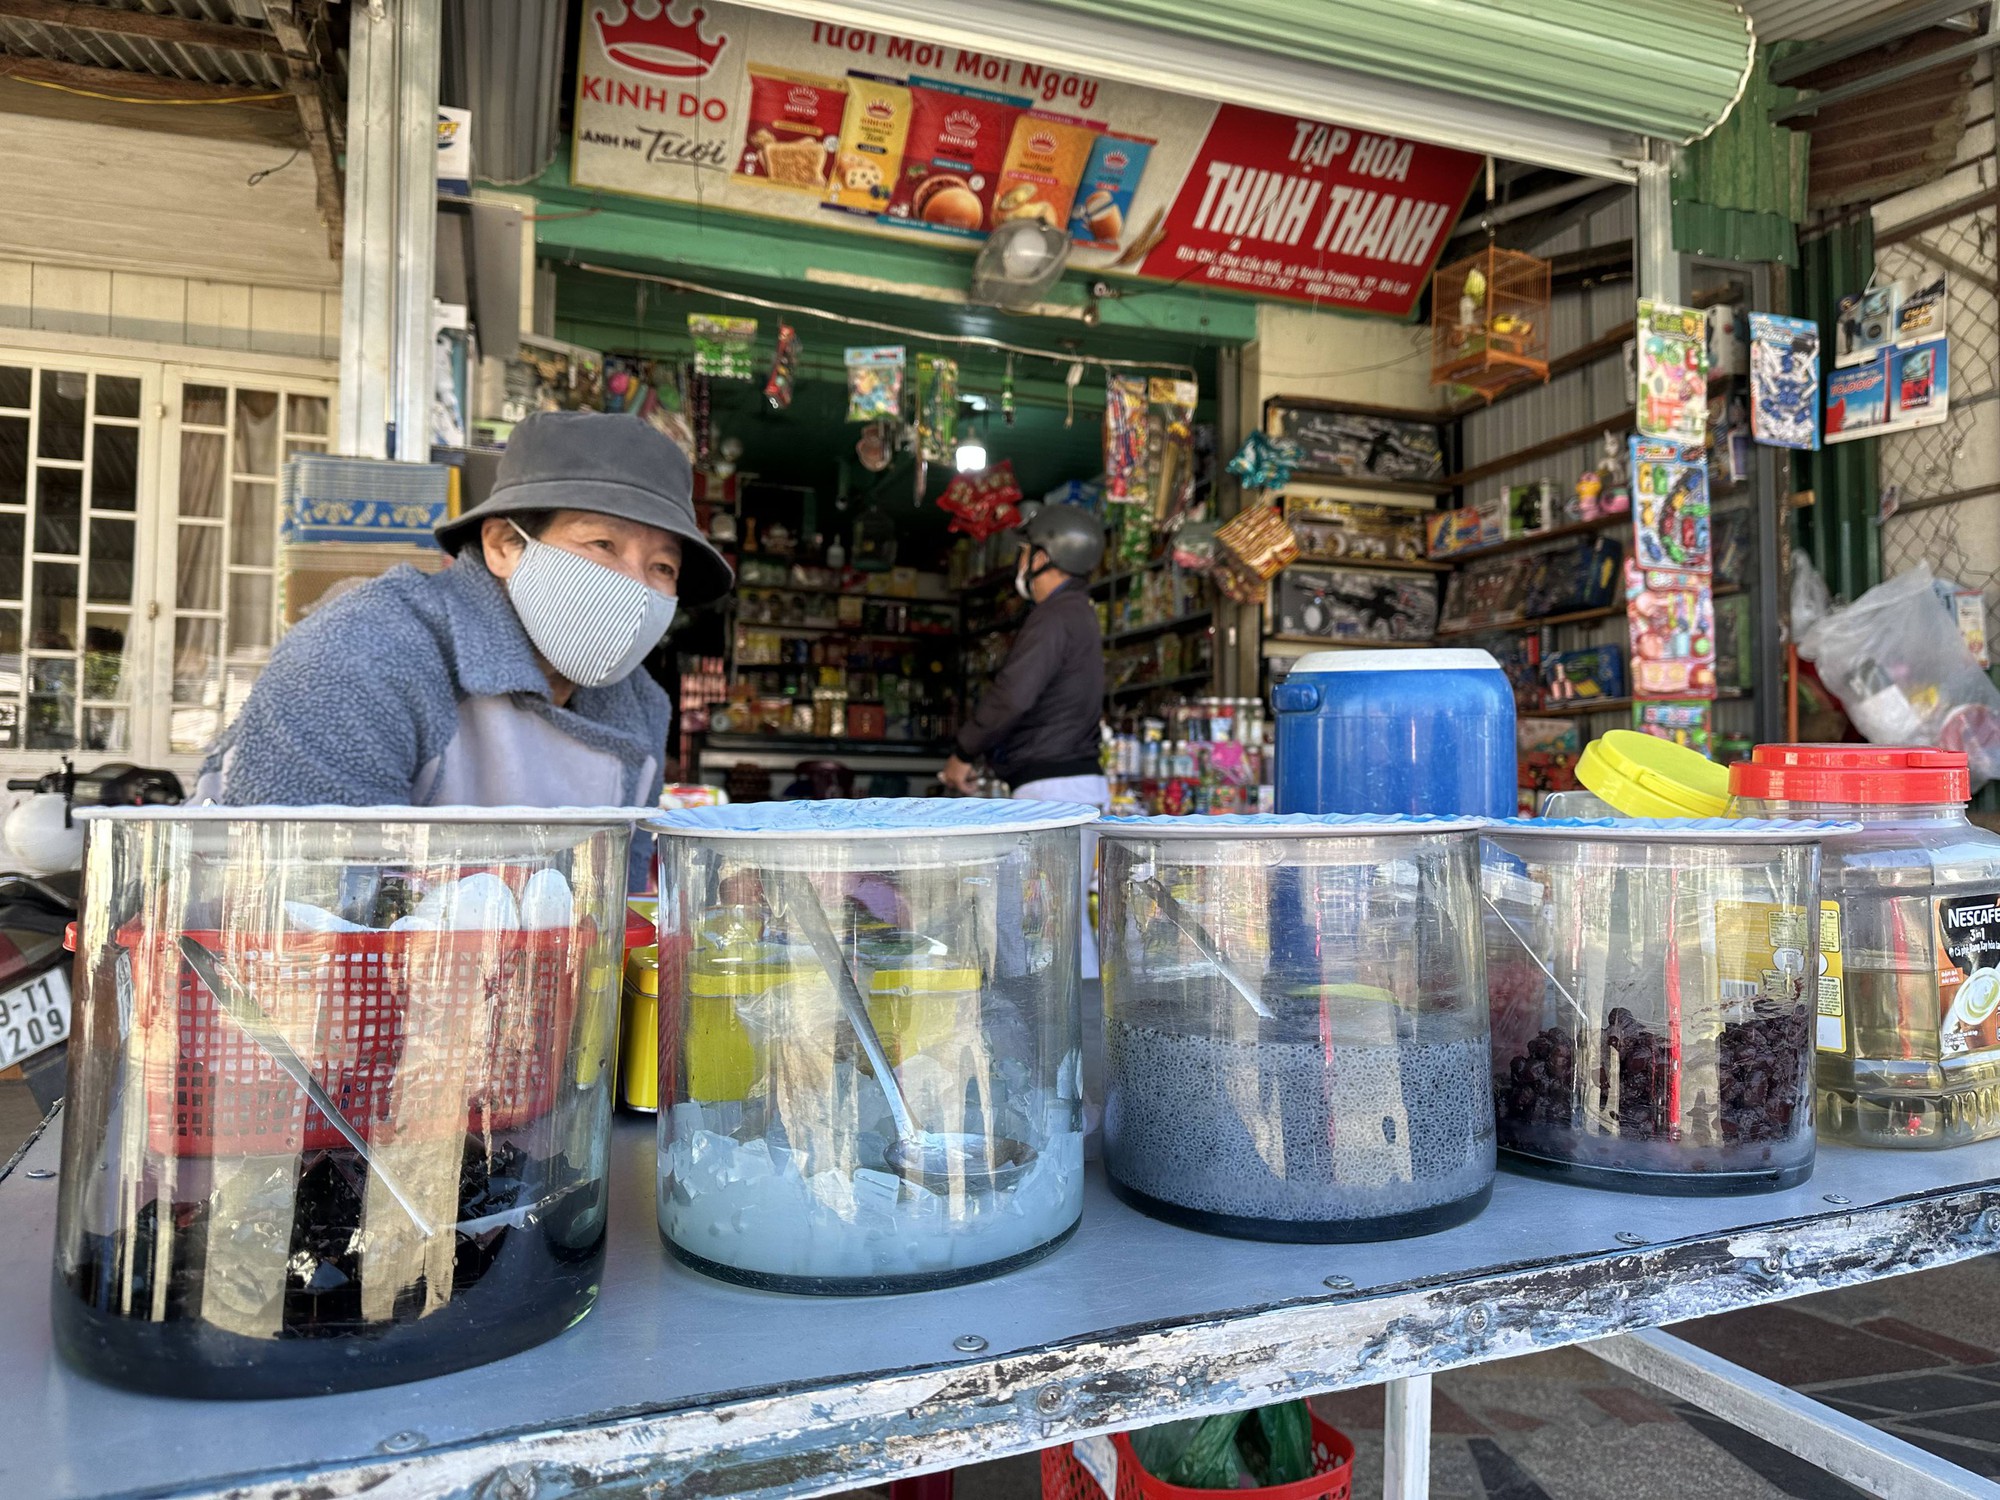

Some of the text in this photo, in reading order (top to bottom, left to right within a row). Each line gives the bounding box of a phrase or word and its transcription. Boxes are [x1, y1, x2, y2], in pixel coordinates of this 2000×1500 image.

[582, 74, 728, 123] KINH DO
[1288, 120, 1351, 174] TẠP
[1191, 160, 1450, 267] THỊNH THANH
[1969, 927, 1985, 942] 3in1
[0, 1007, 64, 1063] 209
